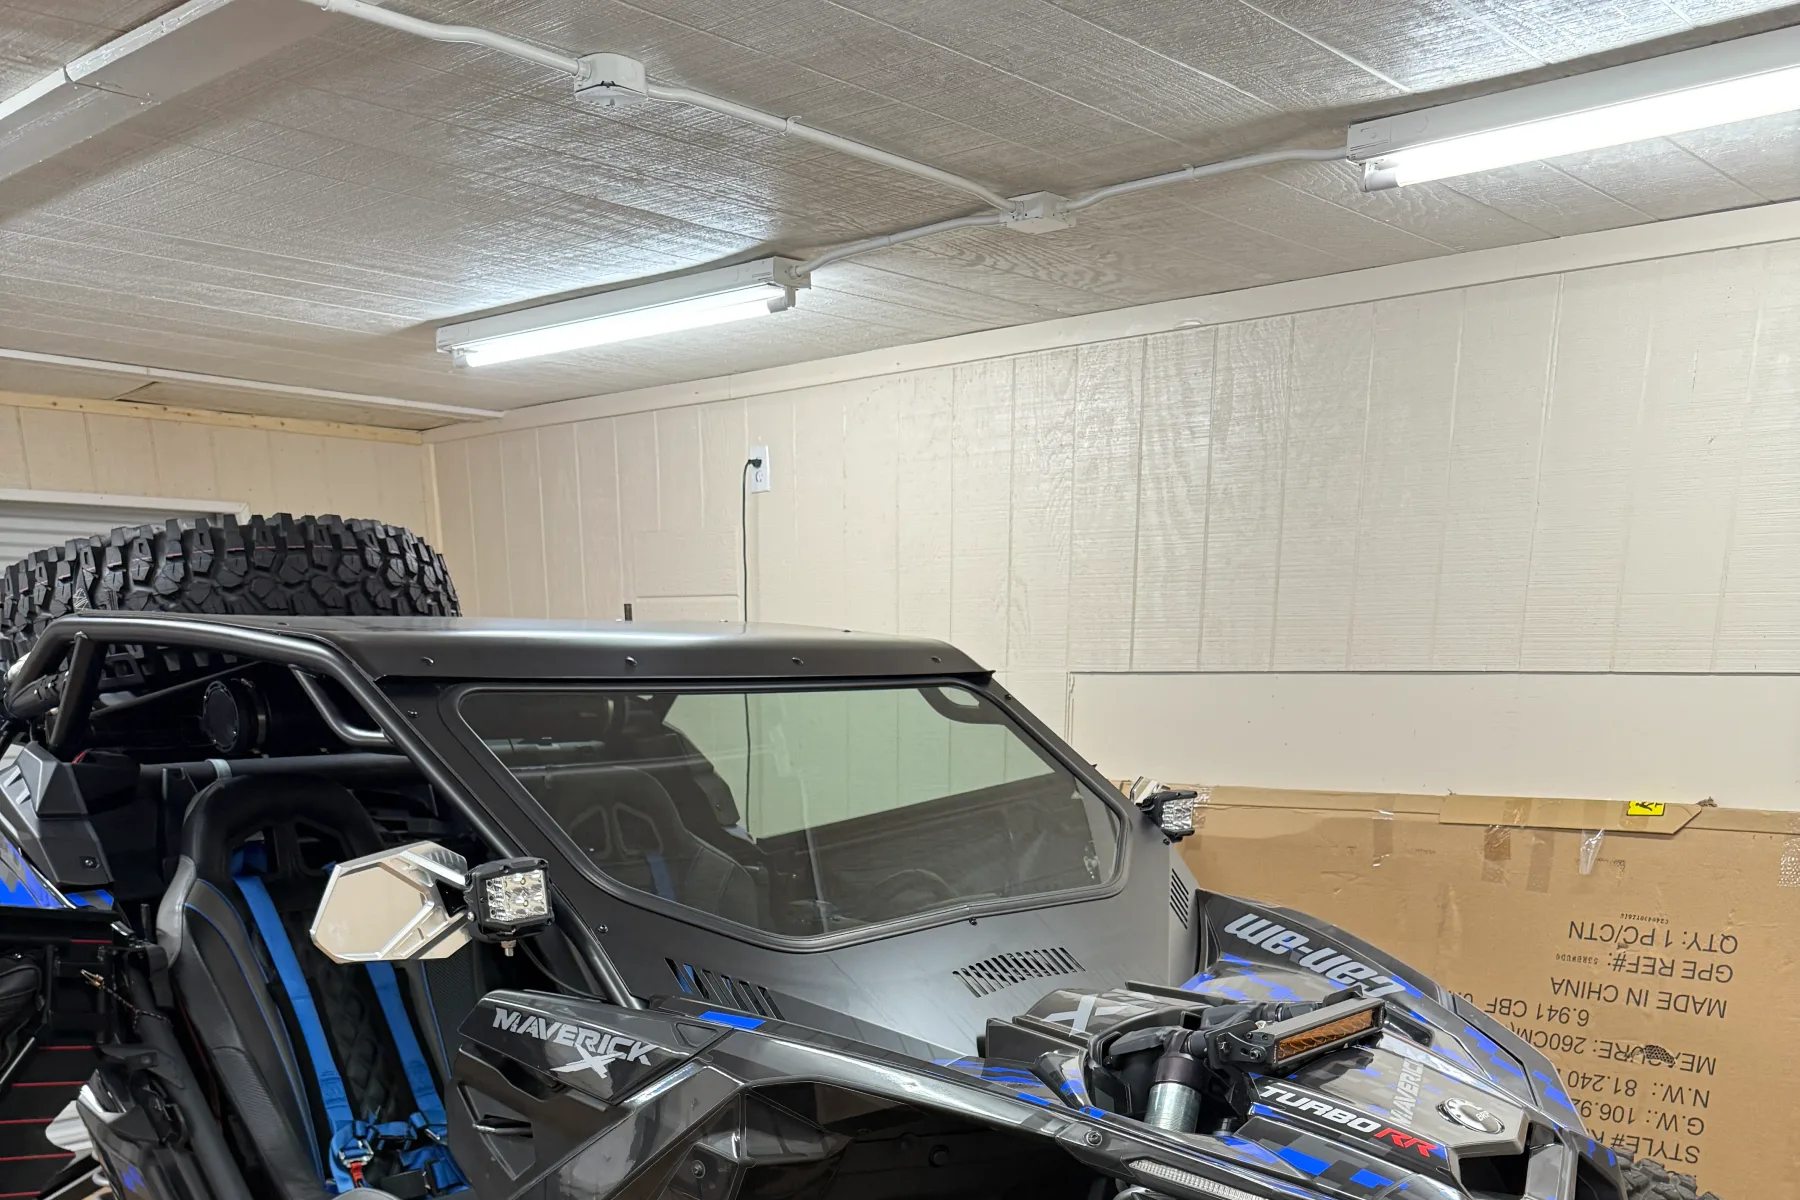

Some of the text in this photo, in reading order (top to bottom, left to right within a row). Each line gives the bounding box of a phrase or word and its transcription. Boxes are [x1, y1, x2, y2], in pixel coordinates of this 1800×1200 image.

[1568, 920, 1738, 955] QTY: 1 PC/CTN
[1607, 952, 1675, 978] REF#:
[1681, 960, 1734, 984] GPE
[1484, 997, 1528, 1018] CBF
[1550, 976, 1727, 1019] MADE IN CHINA
[1536, 1003, 1590, 1027] 6.941
[491, 1006, 659, 1066] MAVERICK
[1592, 1039, 1717, 1076] MEURE:
[1567, 1070, 1710, 1109] N.W.: 81.240
[1259, 1085, 1438, 1158] TURBO RR
[1646, 1109, 1705, 1136] G.W.:
[1610, 1133, 1700, 1164] STYLE#
